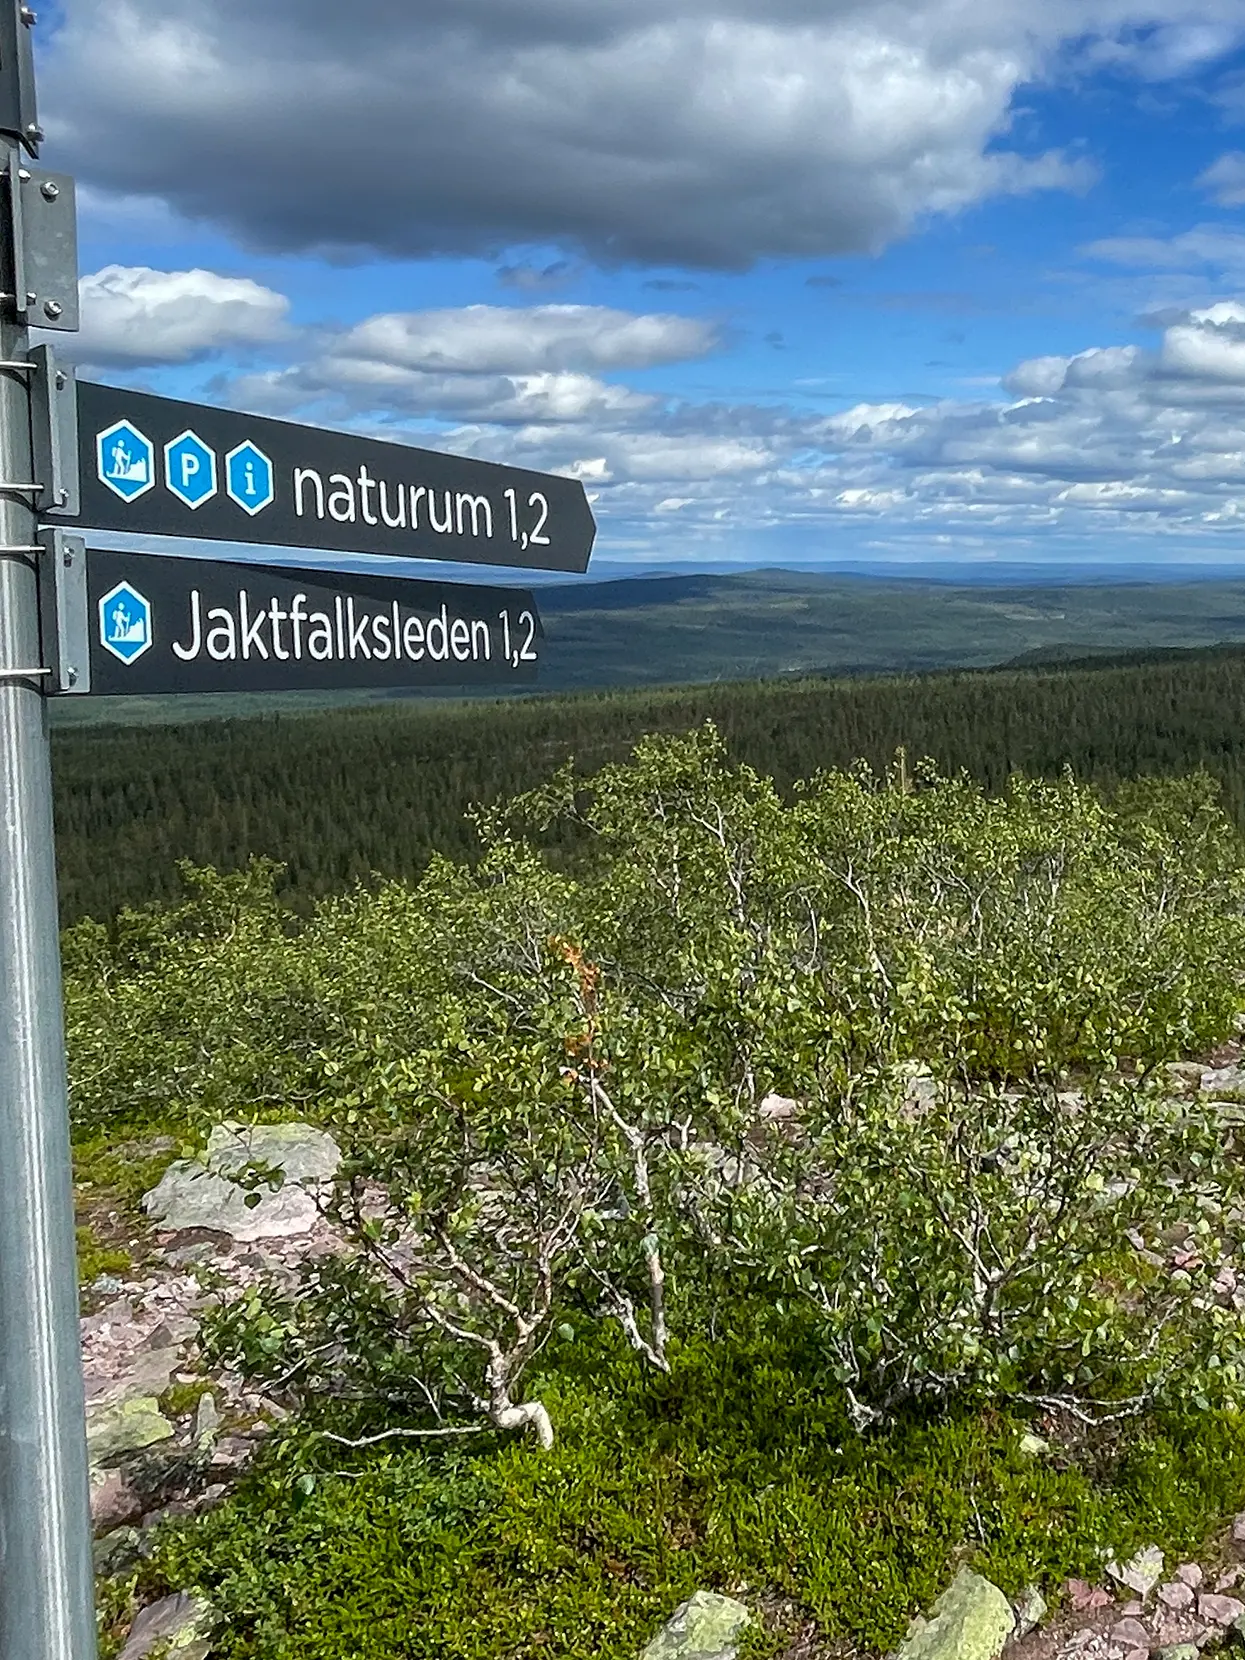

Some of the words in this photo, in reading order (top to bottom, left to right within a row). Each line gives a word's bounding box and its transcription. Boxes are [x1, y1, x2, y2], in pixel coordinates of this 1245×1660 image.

[181, 453, 200, 487] P
[244, 462, 257, 495] i
[294, 464, 493, 538] naturum
[503, 488, 550, 550] 1,2
[172, 589, 490, 661] Jaktfalksleden
[499, 610, 537, 668] 1,2
